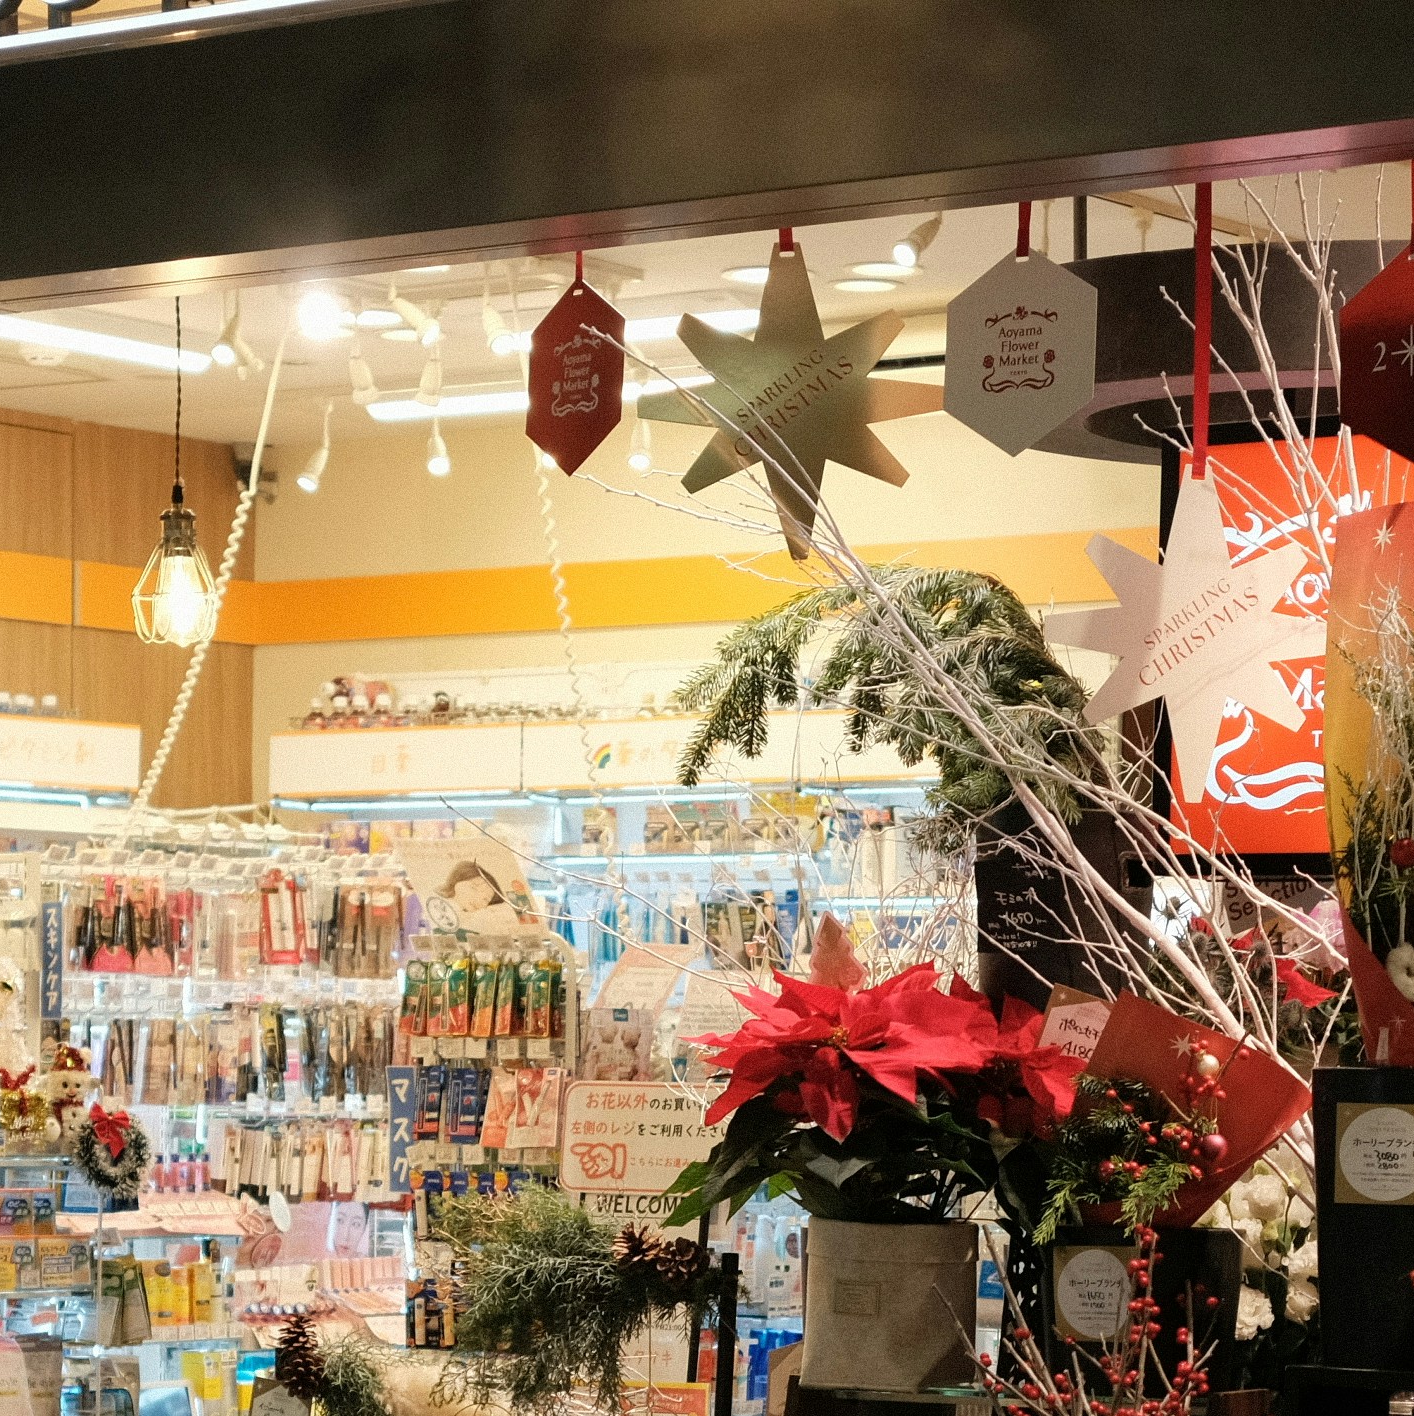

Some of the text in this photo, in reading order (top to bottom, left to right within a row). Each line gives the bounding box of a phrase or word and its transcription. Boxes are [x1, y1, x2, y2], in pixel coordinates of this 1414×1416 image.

[998, 325, 1042, 339] Aoyama
[999, 353, 1039, 366] Market
[1000, 340, 1039, 352] Flower
[734, 355, 855, 458] CHRISTMAS
[735, 350, 825, 423] SPARKLING
[1137, 586, 1261, 687] CHRISTMAS
[1142, 577, 1233, 651] SPARKLING
[45, 908, 61, 1011] スキンケア
[391, 1079, 410, 1184] マスク
[586, 1092, 712, 1113] お花以外のお買い
[596, 1195, 686, 1216] WELCOM
